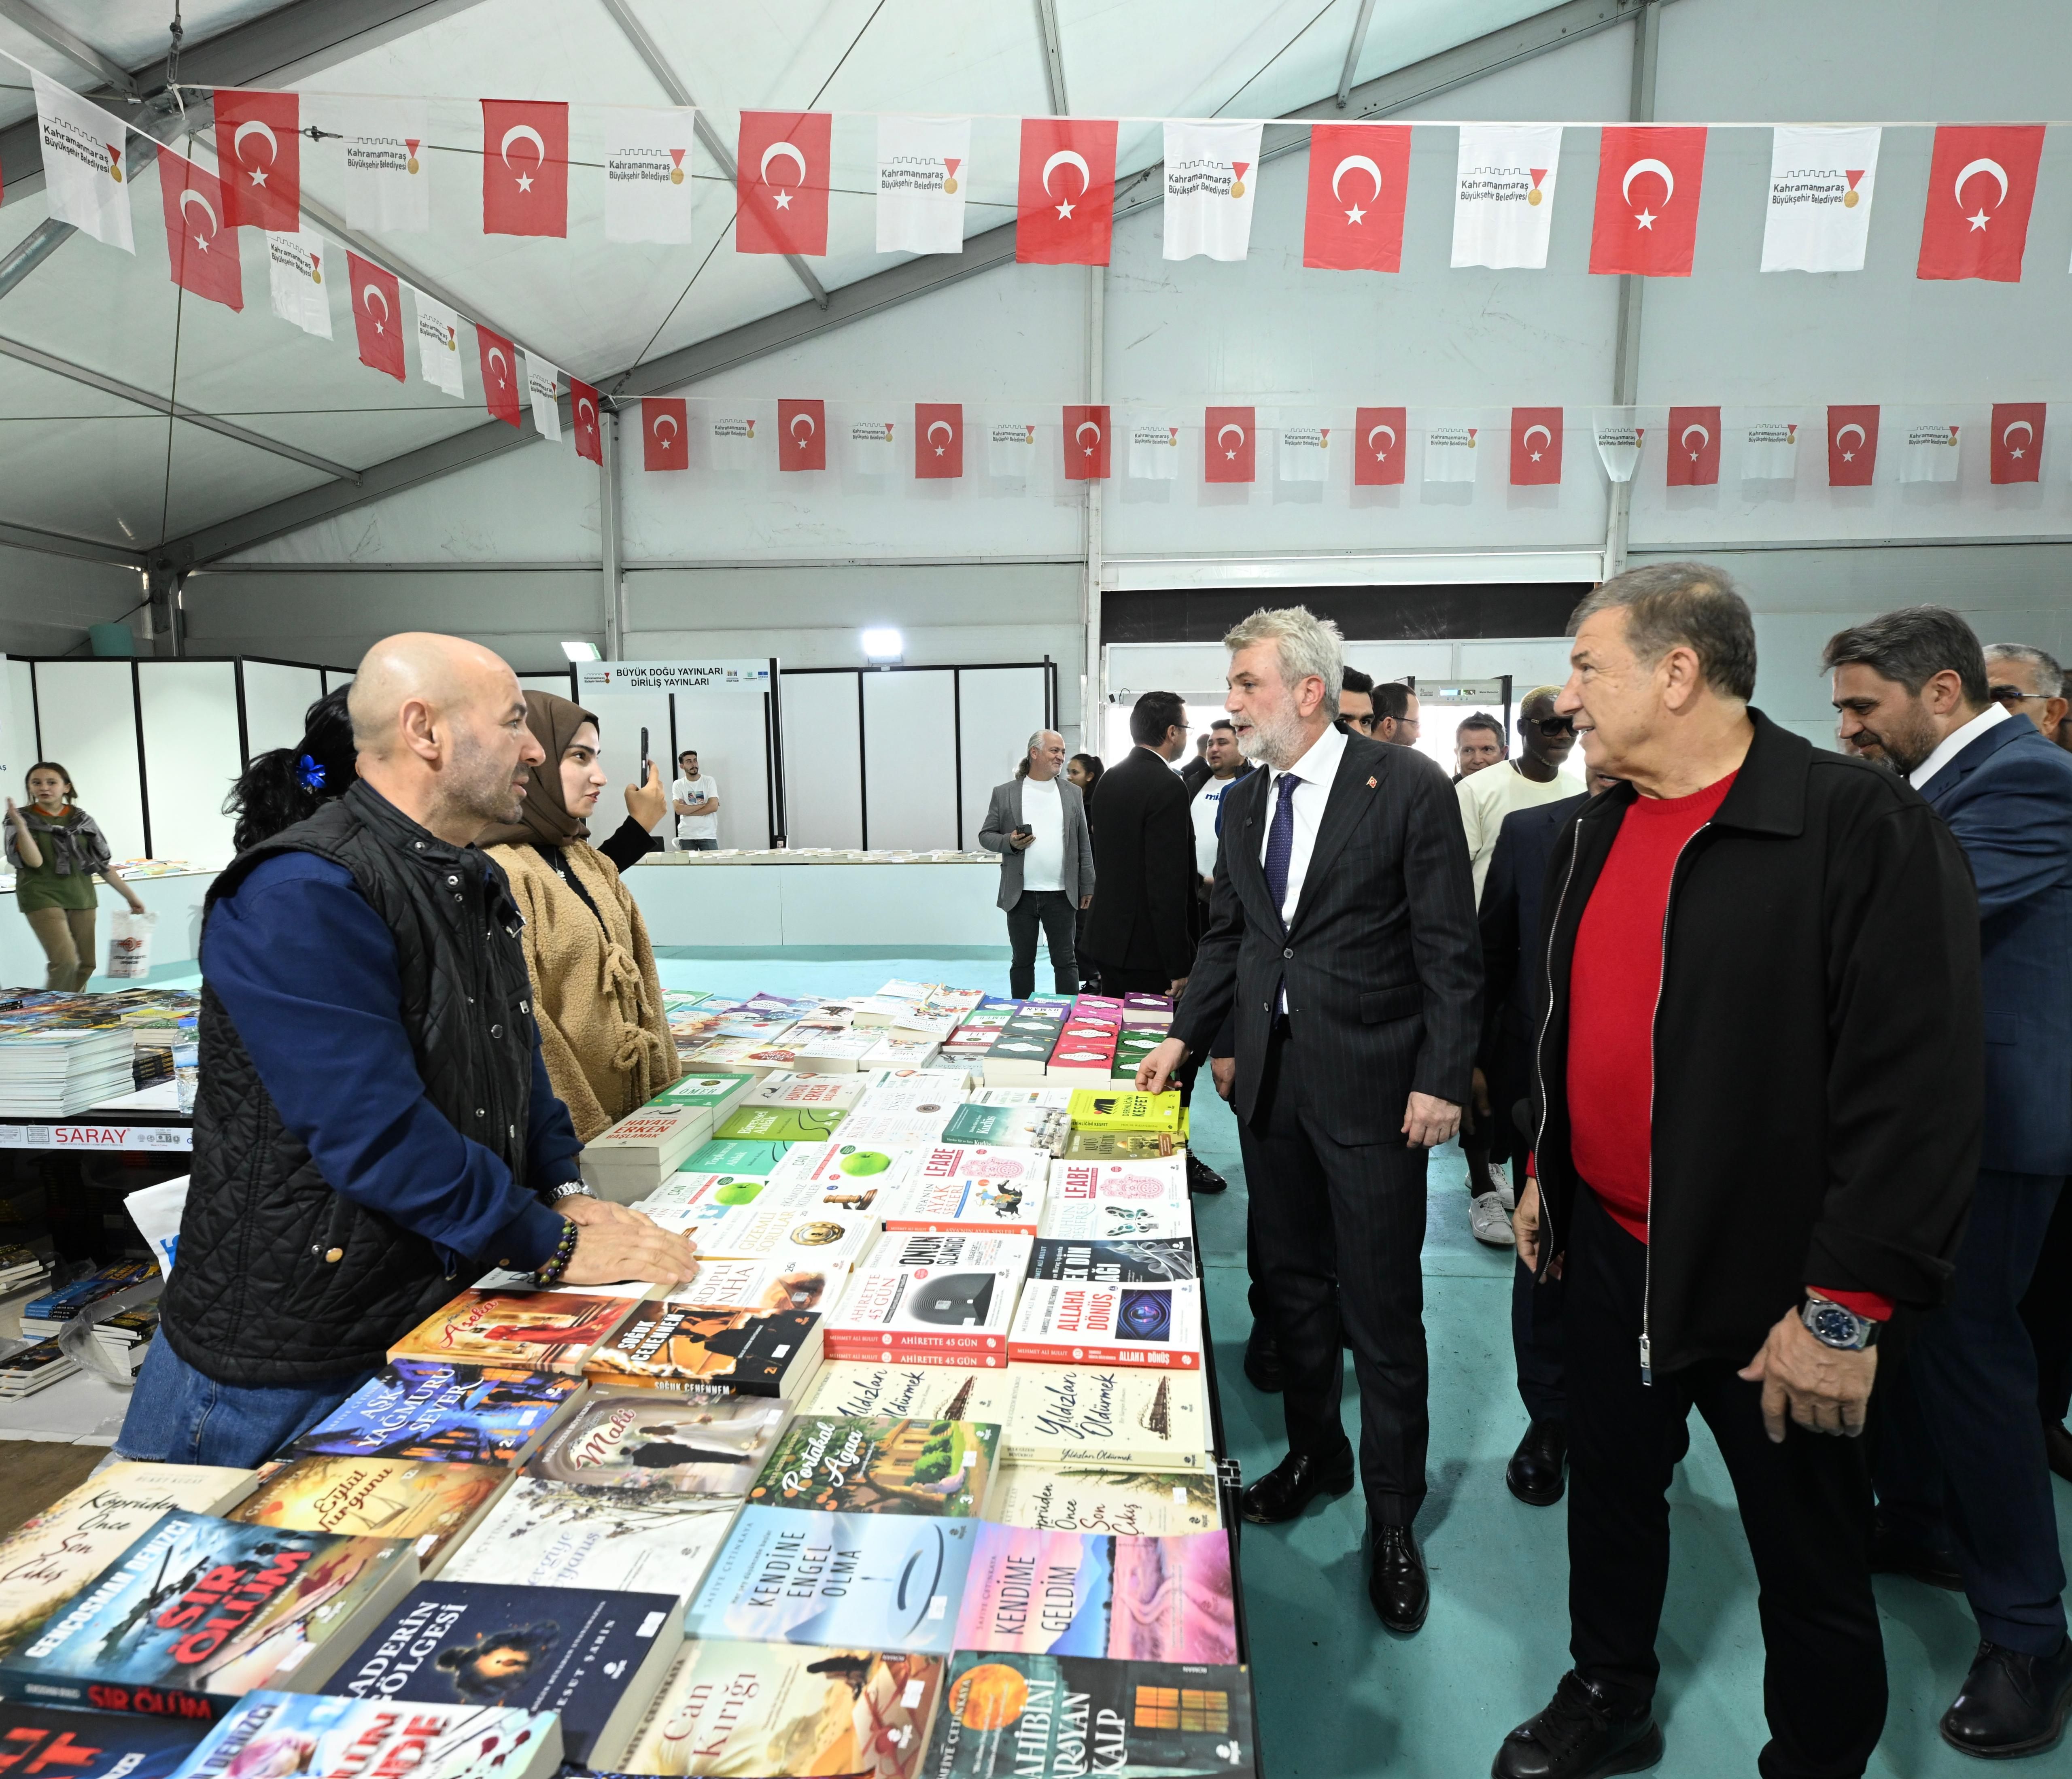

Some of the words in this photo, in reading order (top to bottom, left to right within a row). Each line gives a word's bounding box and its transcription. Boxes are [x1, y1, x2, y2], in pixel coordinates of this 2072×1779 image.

[44, 125, 108, 165] Kahramanmaraş
[45, 136, 80, 159] Büyükşehir
[81, 152, 110, 174] Belediyesi
[348, 148, 406, 160] Kahramanmaraş
[348, 159, 380, 170] Büyükşehir
[380, 159, 406, 171] Belediyesi
[609, 161, 670, 172] Kahramanmaraş
[609, 171, 640, 181] Büyükşehir
[641, 171, 670, 182] Belediyesi
[882, 169, 943, 180] Kahramanmaraş
[1169, 173, 1231, 185] Kahramanmaraş
[882, 180, 912, 190] Büyükşehir
[915, 180, 943, 191] Belediyesi
[1169, 183, 1199, 196] Büyükşehir
[1201, 182, 1230, 196] Belediyesi
[1461, 190, 1495, 201] Büyükşehir
[1495, 191, 1527, 202] Belediyesi
[1462, 180, 1529, 191] Kahramanmaraş
[1772, 192, 1810, 206] Büyükşehir
[1811, 193, 1843, 206] Belediyesi
[1773, 183, 1844, 194] Kahramanmaraş
[271, 244, 311, 270] Kahramanmaraş
[272, 253, 295, 267] Büyükşehir
[616, 668, 647, 676] BÜYÜK
[650, 667, 675, 676] DOĞU
[631, 677, 661, 688] DİRİLİŞ
[784, 1085, 811, 1100] HAYATA
[802, 1085, 830, 1100] ERKEN
[1122, 1095, 1133, 1116] DERİNLİĞİNİ
[1132, 1095, 1148, 1117] KEŞFET
[55, 1128, 126, 1143] SARAY
[737, 1111, 769, 1134] Bireysel
[976, 1116, 996, 1134] Kudüs
[705, 1142, 738, 1165] Toplumsal
[792, 1155, 810, 1165] CAN
[668, 1189, 687, 1200] CAN
[926, 1185, 952, 1213] AYAK
[943, 1185, 964, 1214] SESLERİ
[739, 1212, 777, 1250] GİZEMLİ
[756, 1211, 796, 1252] SORULAR
[850, 1274, 880, 1322] AHİRETTE
[874, 1278, 896, 1306] GÜN
[867, 1308, 883, 1320] 45
[1087, 1293, 1117, 1331] DÖNÜŞ
[618, 1320, 656, 1349] SOĞUK
[631, 1314, 685, 1361] CEHENNEM
[901, 1336, 943, 1346] AHİRETTE
[947, 1338, 955, 1346] 45
[958, 1337, 978, 1346] GÜN
[901, 1354, 943, 1364] AHİRETTE
[957, 1356, 977, 1365] GÜN
[1148, 1351, 1170, 1365] DÖNÜŞ
[655, 1380, 681, 1391] SOĞUK
[684, 1383, 730, 1395] CEHENNEM
[356, 1368, 455, 1448] YAĞMURU
[360, 1388, 405, 1420] AŞK
[409, 1376, 484, 1432] SEVER
[1035, 1371, 1085, 1439] Yıldızları
[1075, 1373, 1114, 1437] Öldürmek
[575, 1409, 636, 1471] Mahi
[782, 1421, 836, 1491] Portakal
[824, 1429, 863, 1487] Ağacı
[314, 1469, 368, 1516] Eylül
[77, 1509, 132, 1531] Önce
[1051, 1499, 1078, 1530] Önce
[1080, 1503, 1110, 1531] Son
[1112, 1504, 1144, 1536] Çıkış
[40, 1533, 93, 1558] Son
[1, 1559, 68, 1585] Çıkış
[749, 1531, 805, 1608] KENDİNE
[787, 1544, 832, 1599] ENGEL
[822, 1550, 862, 1597] OLMA
[25, 1570, 136, 1658] GENÇOSMAN
[125, 1521, 192, 1574] DENİZCİ
[156, 1565, 244, 1630] SIR
[995, 1554, 1036, 1635] KENDİME
[1041, 1565, 1077, 1633] GELDİM
[167, 1550, 312, 1663] ÖLÜM
[337, 1601, 440, 1699] ADERİN
[369, 1603, 468, 1701] ÖLGESİ
[88, 1685, 129, 1710] SIR
[134, 1686, 211, 1719] ÖLÜM
[663, 1683, 713, 1742] Can
[693, 1673, 760, 1758] Kırığı
[1092, 1709, 1127, 1776] KALP
